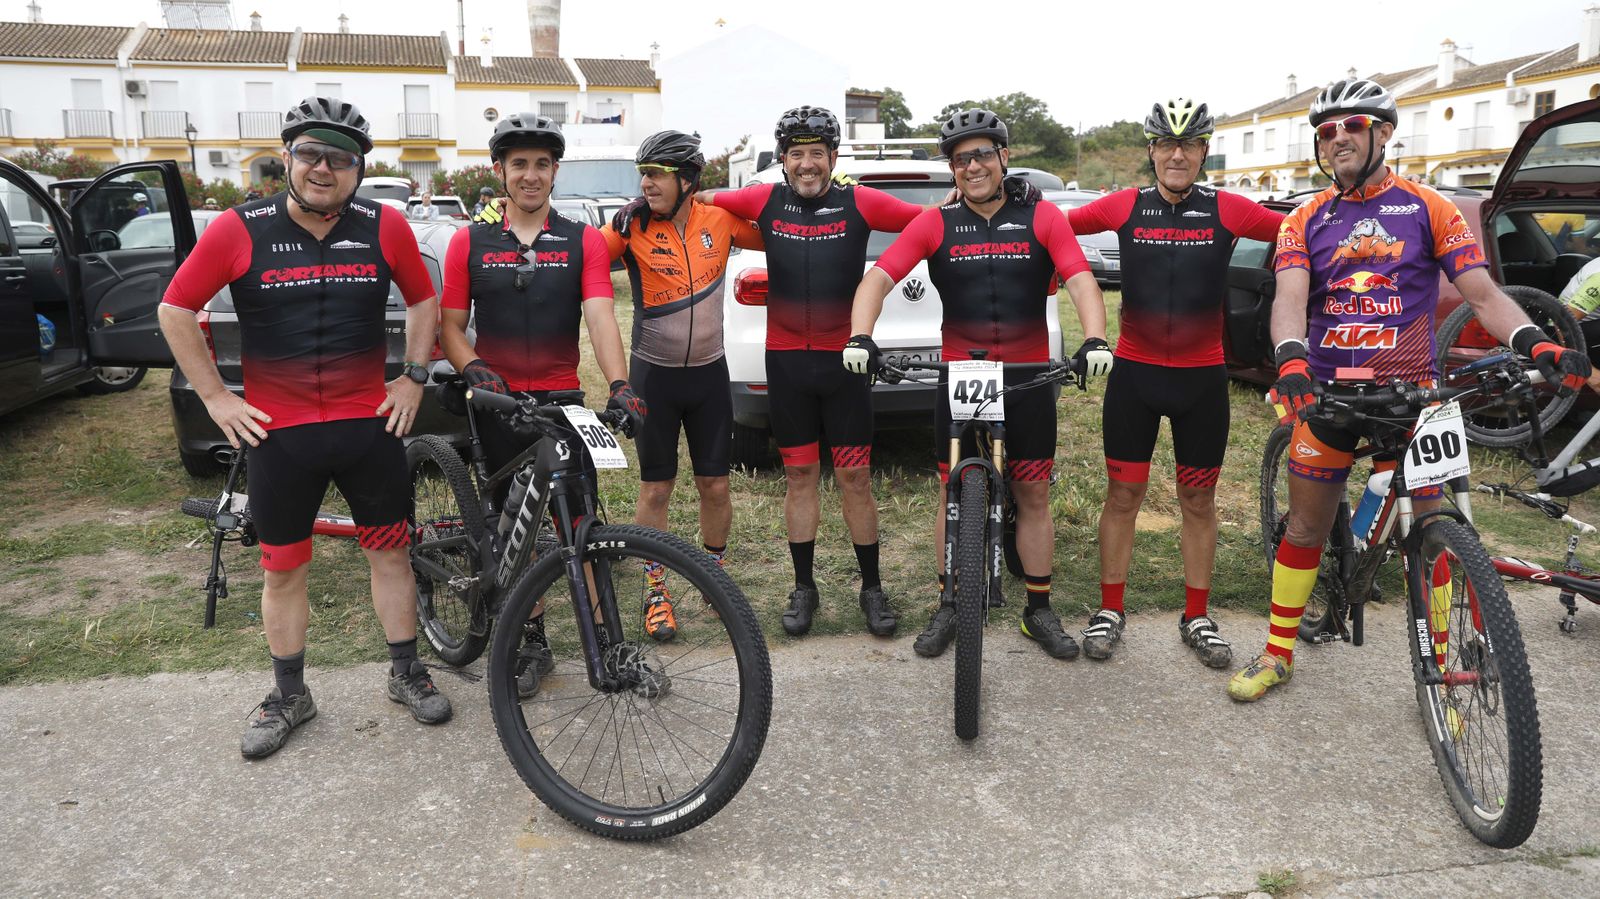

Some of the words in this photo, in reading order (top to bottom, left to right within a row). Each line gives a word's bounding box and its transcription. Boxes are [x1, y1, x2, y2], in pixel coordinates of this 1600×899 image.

[772, 219, 847, 237] CORZANOS
[1133, 227, 1214, 241] CORZANOS
[1313, 219, 1343, 230] DUNLOP
[272, 242, 303, 252] GOBIK
[949, 241, 1030, 257] CORZANOS
[482, 251, 569, 264] CORNOS
[261, 263, 377, 283] CORZANOS
[1323, 295, 1358, 315] Red
[1360, 296, 1403, 316] Bull
[1320, 323, 1398, 349] KTM
[954, 379, 997, 404] 424
[577, 424, 617, 449] 505
[1409, 430, 1461, 467] 190
[496, 473, 541, 588] SCOTT
[587, 540, 626, 551] XXIS
[1415, 618, 1432, 657] ROCKSHOX
